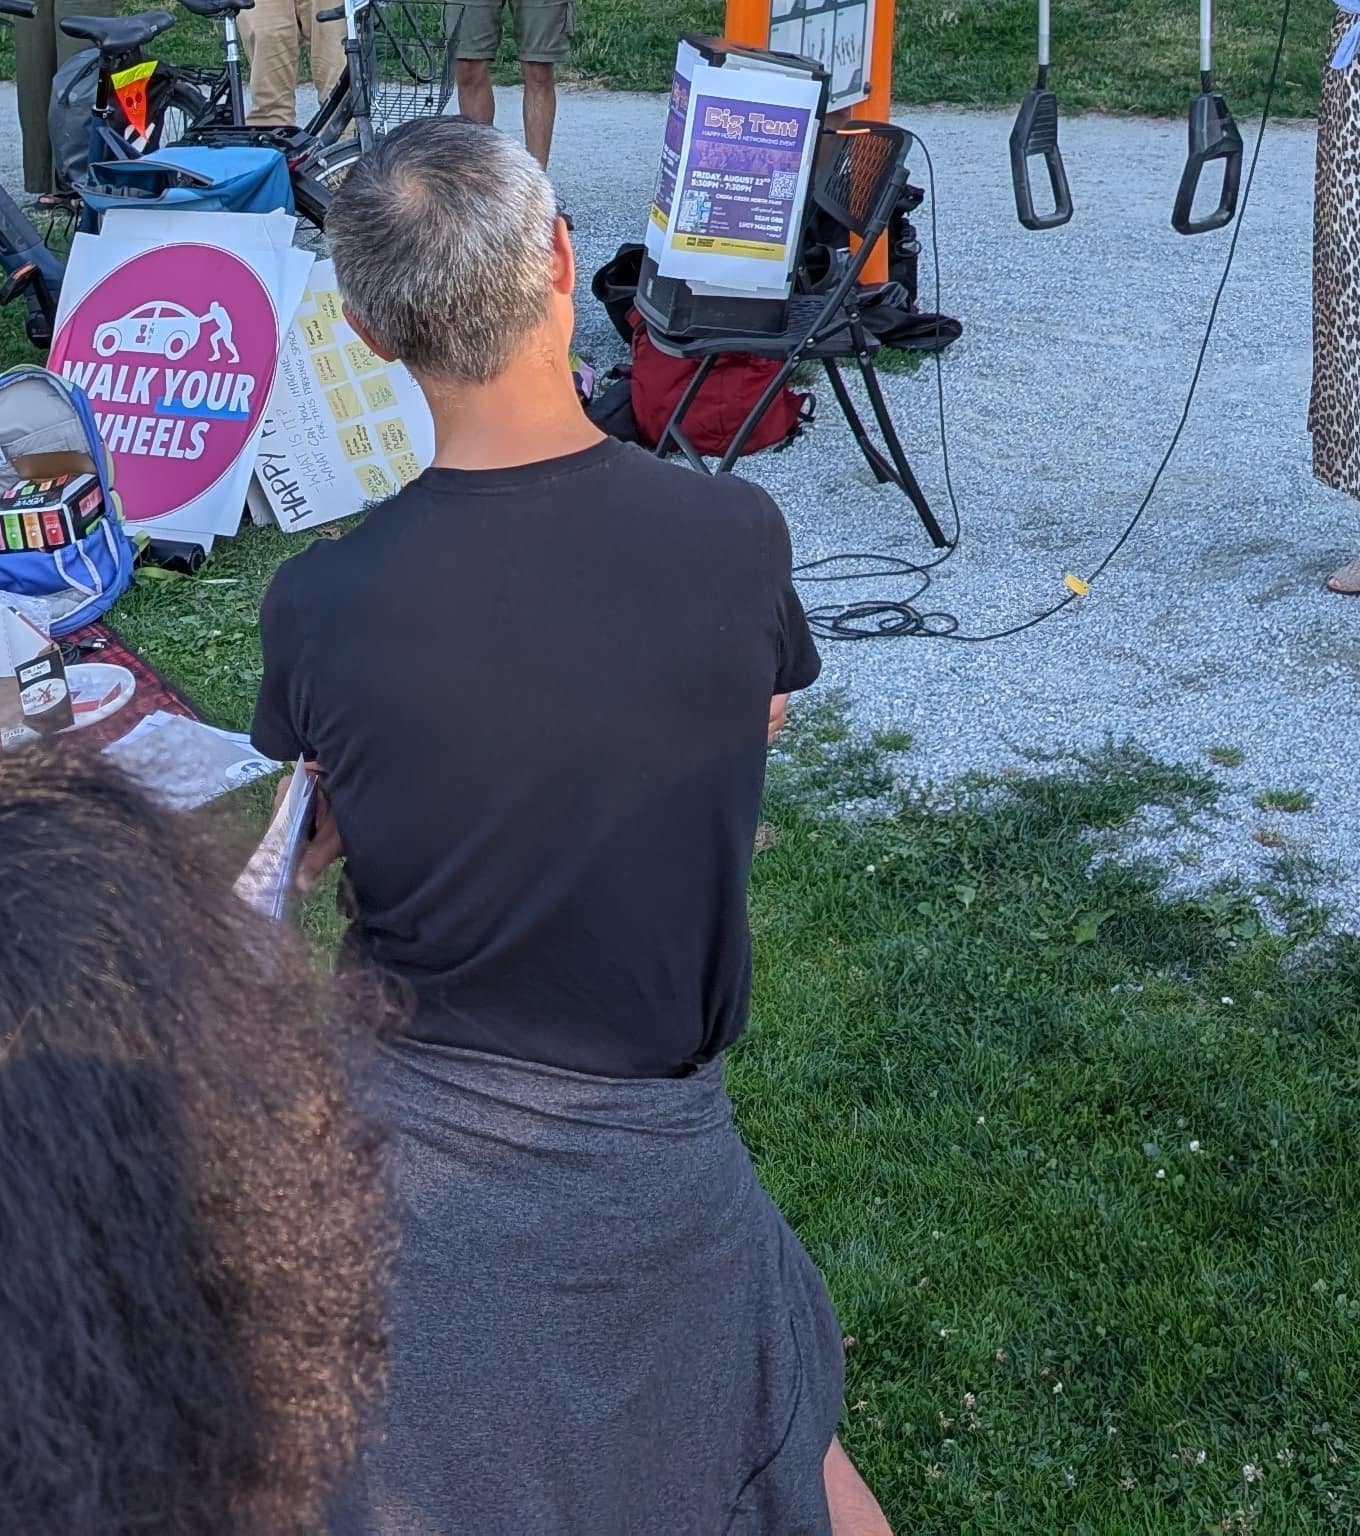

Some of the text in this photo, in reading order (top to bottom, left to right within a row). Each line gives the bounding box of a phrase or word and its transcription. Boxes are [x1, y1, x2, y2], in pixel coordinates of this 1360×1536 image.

[704, 107, 798, 137] Big Tent
[724, 174, 754, 184] AUGUST
[725, 183, 752, 193] 7:30PM
[62, 360, 255, 413] WALK YOUR
[280, 356, 301, 397] IMAGINE
[289, 433, 303, 448] IS
[258, 453, 312, 523] HAPPY
